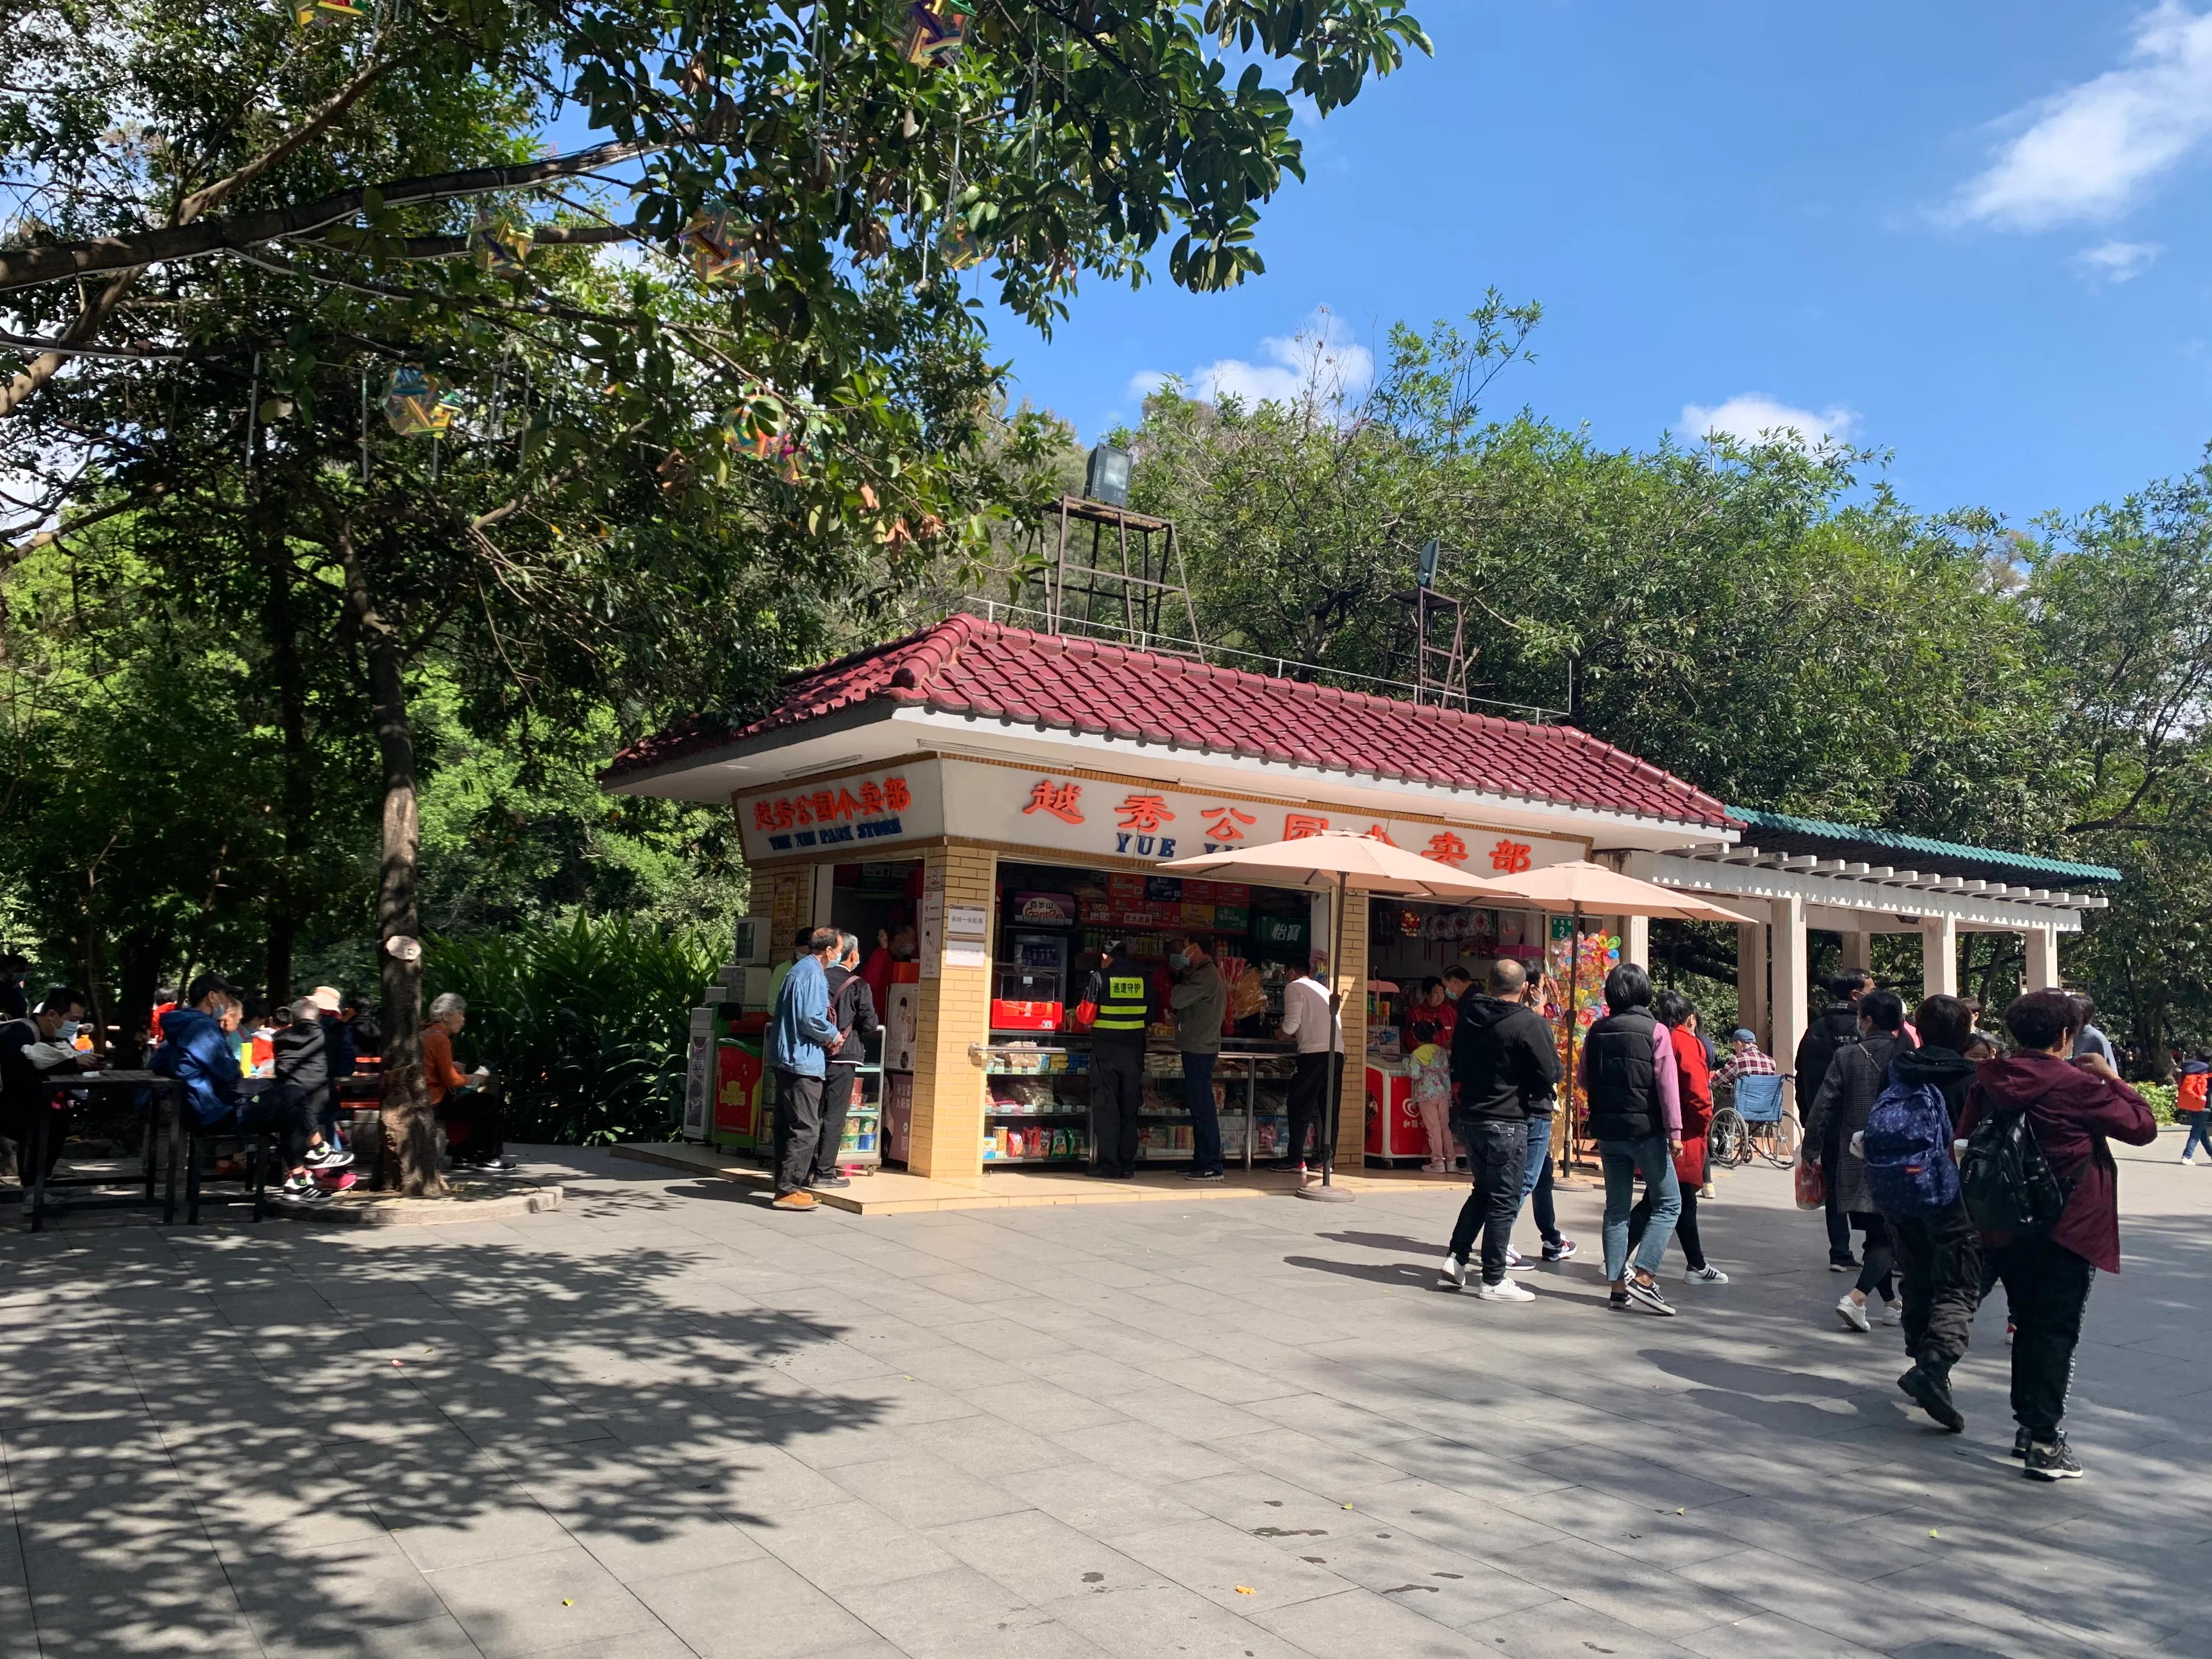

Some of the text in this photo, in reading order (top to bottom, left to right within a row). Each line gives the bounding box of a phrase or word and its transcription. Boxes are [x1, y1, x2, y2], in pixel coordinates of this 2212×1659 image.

[754, 777, 911, 831] 越秀公园小卖部
[819, 825, 855, 844] PARK
[1115, 832, 1176, 857] YUE
